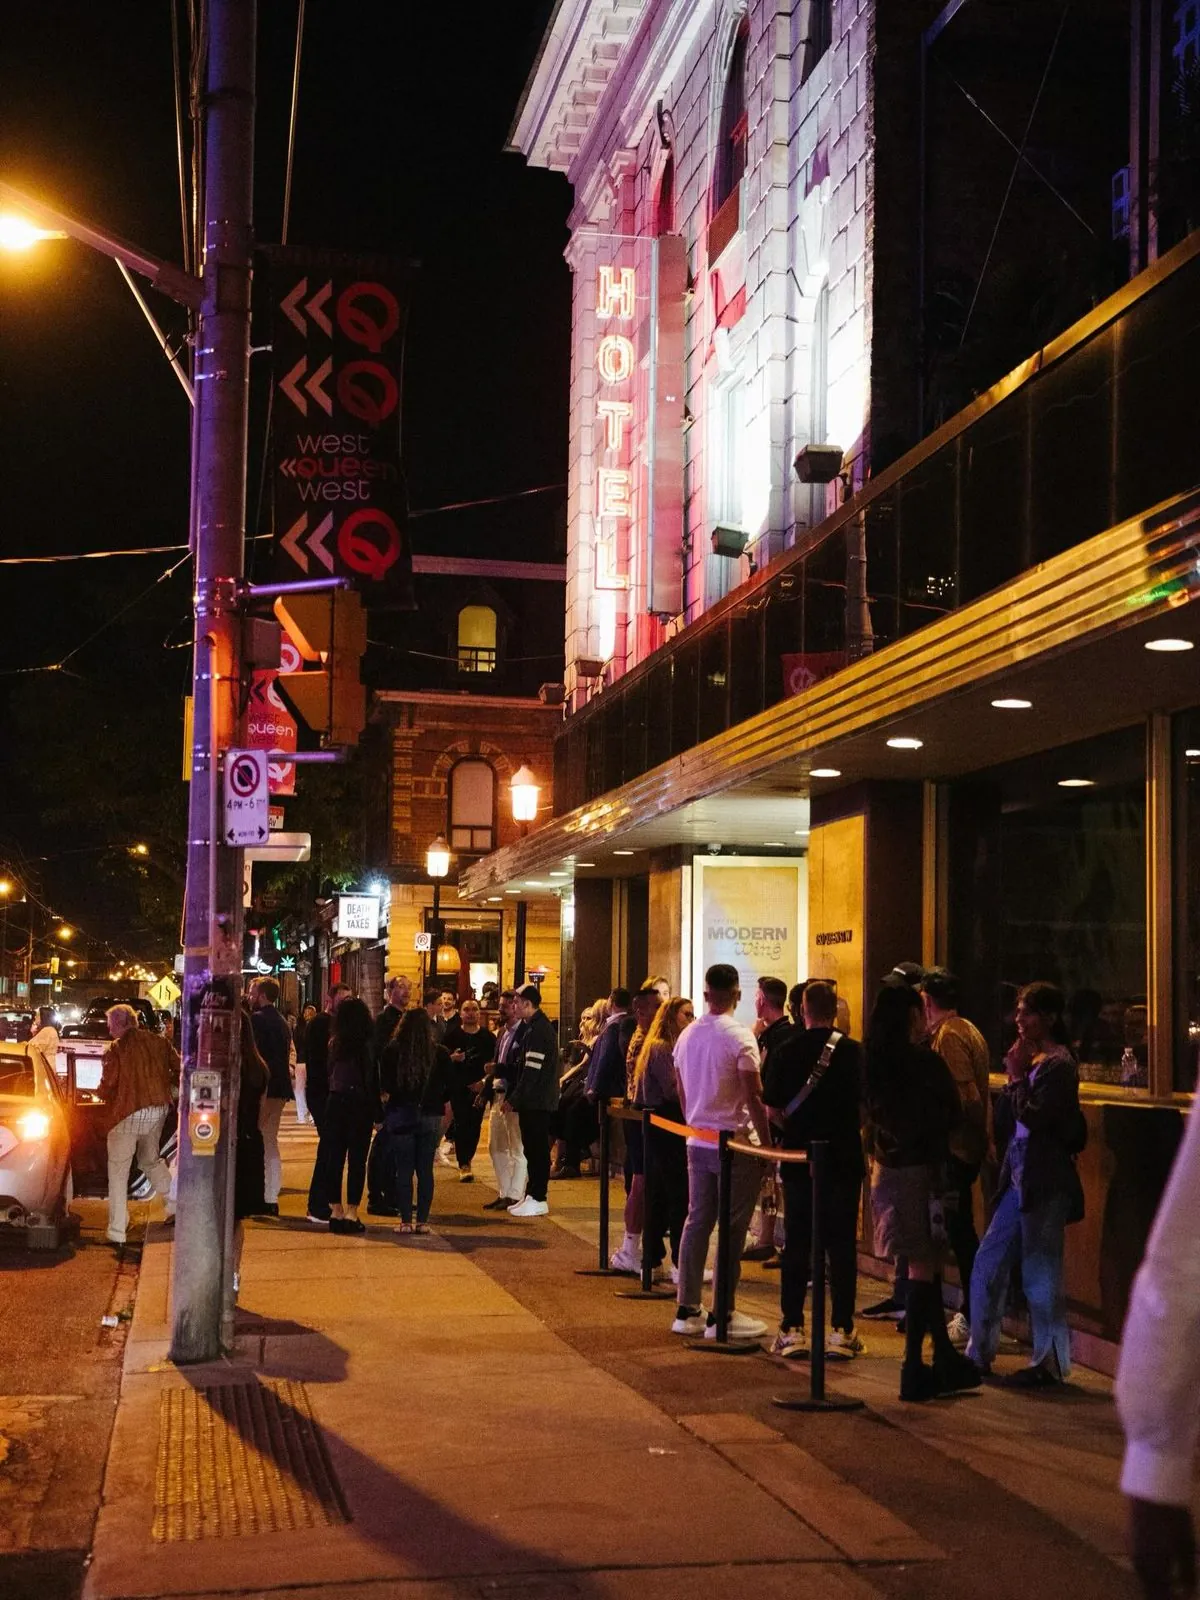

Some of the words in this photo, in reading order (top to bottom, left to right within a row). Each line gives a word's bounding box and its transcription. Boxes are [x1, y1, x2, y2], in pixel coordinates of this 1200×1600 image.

[596, 265, 636, 591] HOTEL
[296, 434, 371, 455] west
[297, 480, 371, 502] west
[338, 508, 401, 580] Q
[346, 917, 370, 929] TAXES
[707, 927, 788, 941] MODERN
